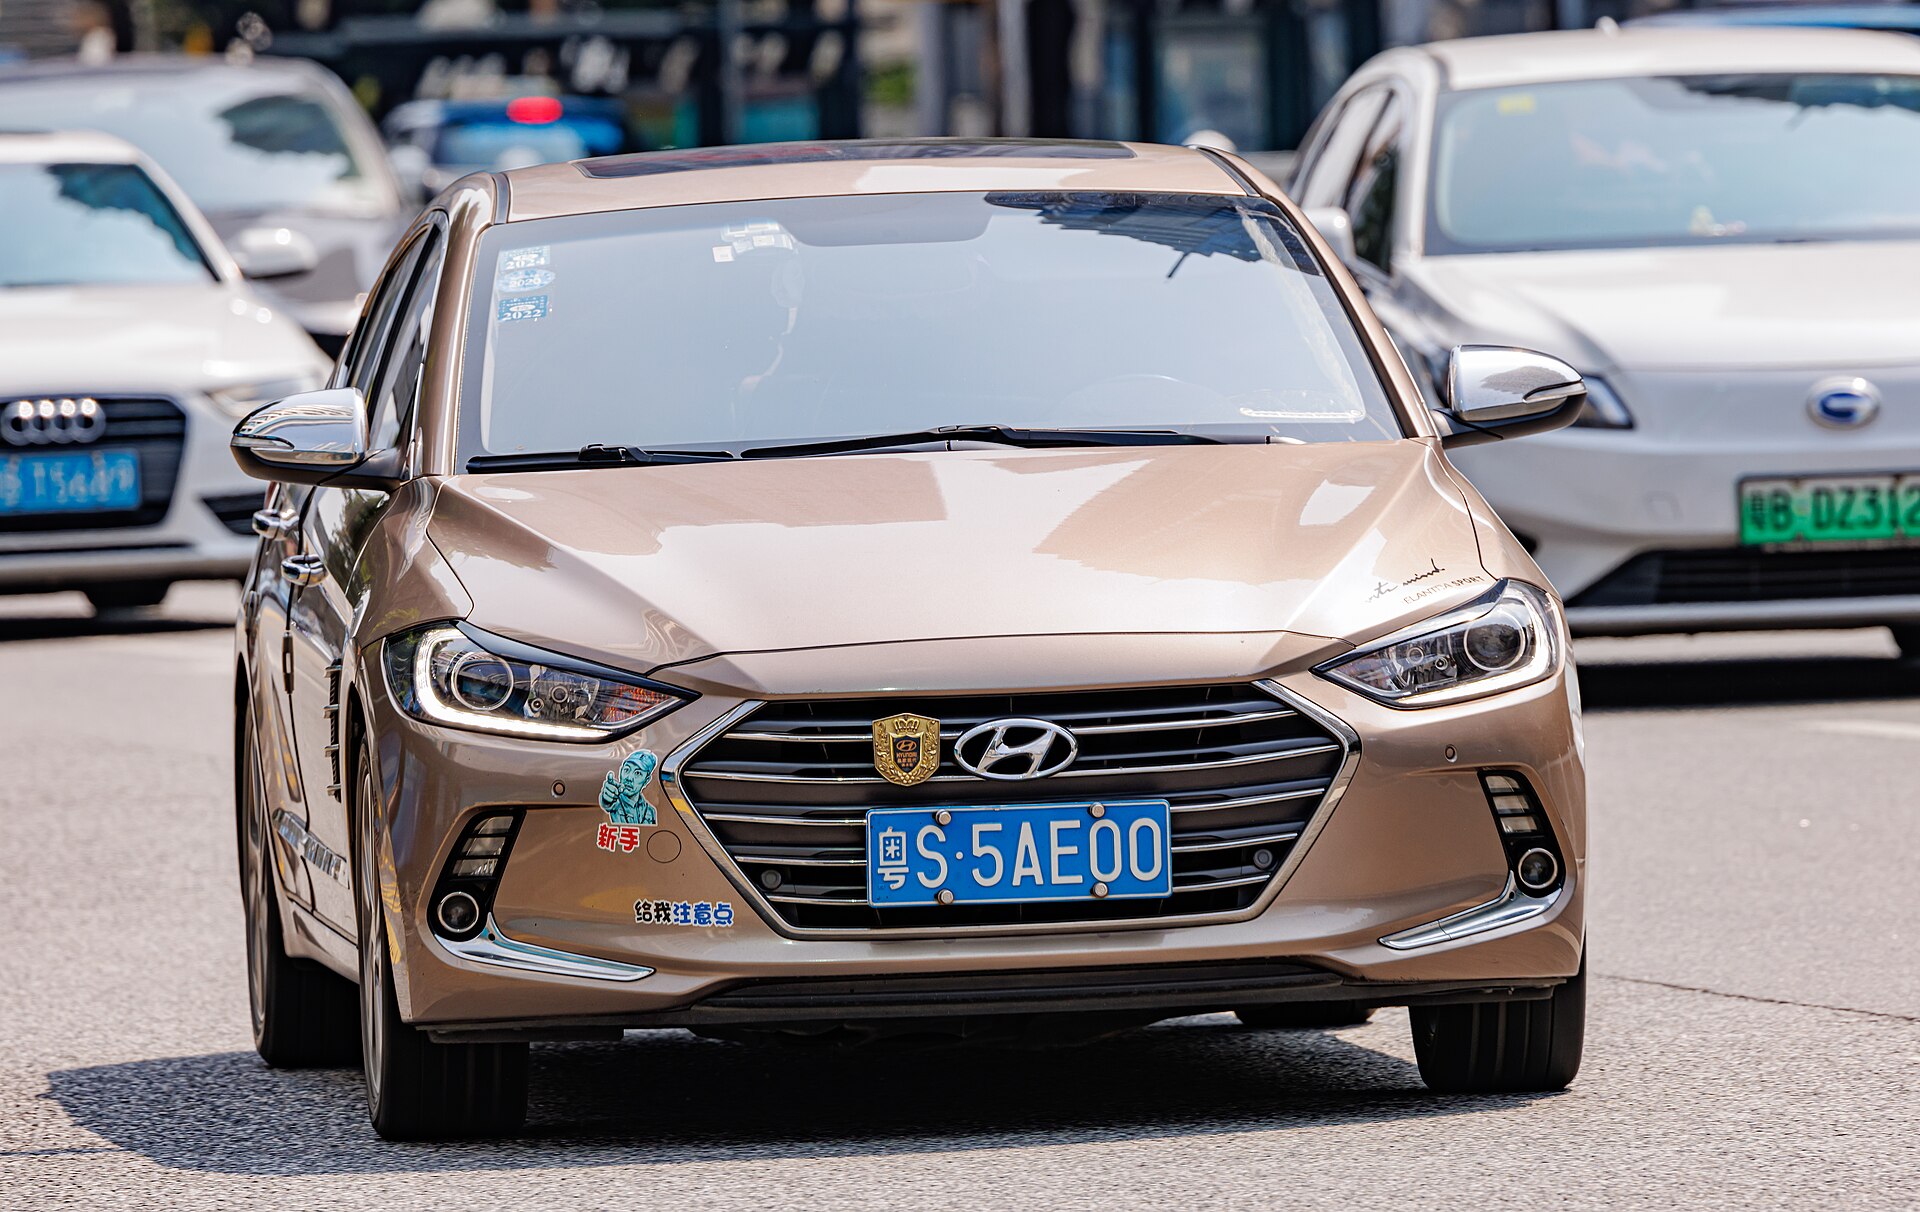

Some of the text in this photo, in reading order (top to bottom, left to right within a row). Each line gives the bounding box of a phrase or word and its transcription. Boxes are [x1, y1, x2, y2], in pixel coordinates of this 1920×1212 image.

[501, 309, 543, 321] 2022
[1451, 575, 1485, 587] SPORT
[597, 824, 639, 851] 新手
[877, 817, 1162, 890] 粤S·5AE00
[635, 901, 733, 925] 给我注意点
